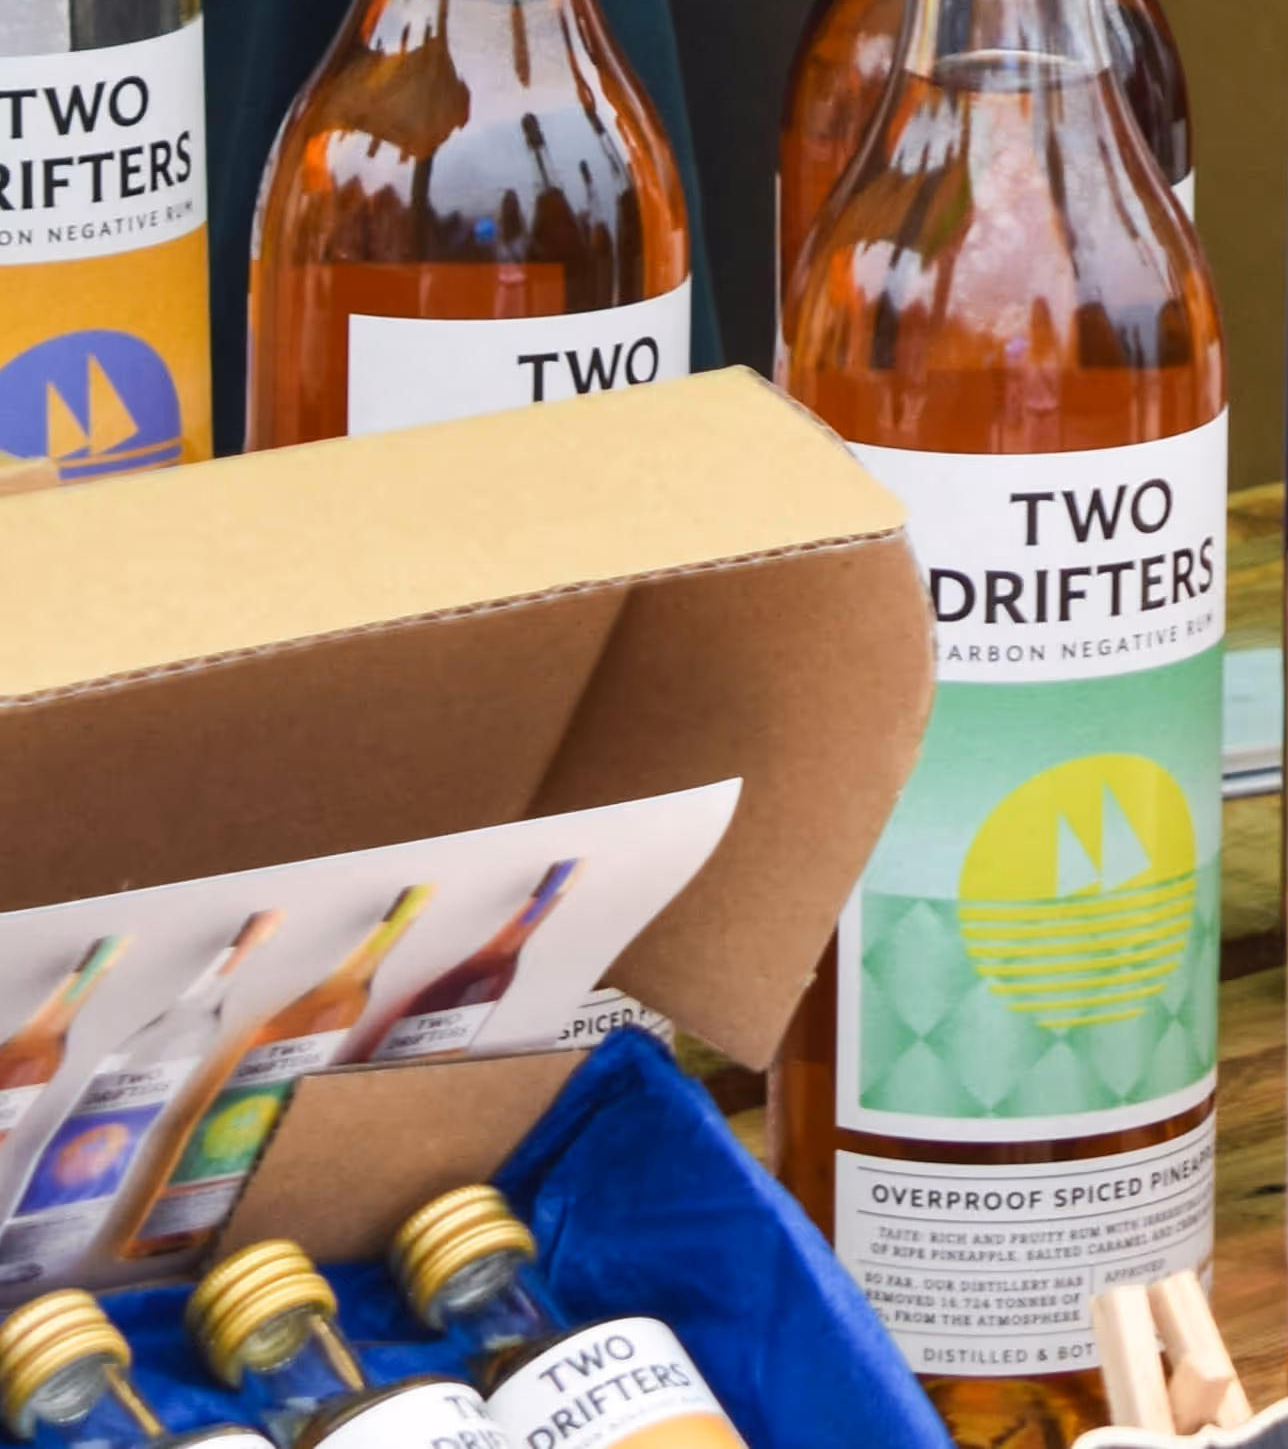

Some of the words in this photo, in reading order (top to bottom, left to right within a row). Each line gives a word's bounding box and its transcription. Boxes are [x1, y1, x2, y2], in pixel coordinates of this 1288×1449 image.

[0, 75, 149, 139] TWO
[48, 210, 158, 244] NEGATIVE
[517, 335, 660, 405] TWO
[1010, 478, 1174, 547] TWO
[930, 536, 1215, 625] DRIFTERS
[1061, 625, 1178, 660] NEGATIVE
[871, 1183, 1042, 1211] OVERPROOF
[1053, 1177, 1143, 1208] SPICED
[870, 1243, 887, 1254] OF
[892, 1245, 926, 1260] RIPE
[1025, 1246, 1082, 1261] SALTED
[930, 1232, 967, 1245] RICH
[973, 1233, 1005, 1245] AND
[1070, 1226, 1100, 1241] RUM
[864, 1271, 884, 1285] SO
[923, 1277, 954, 1291] OUR
[960, 1278, 1050, 1292] DISTILLERY
[1054, 1274, 1084, 1287] HAS
[895, 1310, 937, 1324] FROM
[941, 1312, 971, 1327] THE
[976, 1309, 1081, 1328] ATMOSPHERE
[995, 1296, 1057, 1310] TONNES
[1062, 1293, 1081, 1305] OF
[538, 1334, 635, 1394] TWO
[923, 1347, 1029, 1365] DISTILLED
[1036, 1346, 1049, 1362] &
[526, 1362, 690, 1449] DRIFTERS
